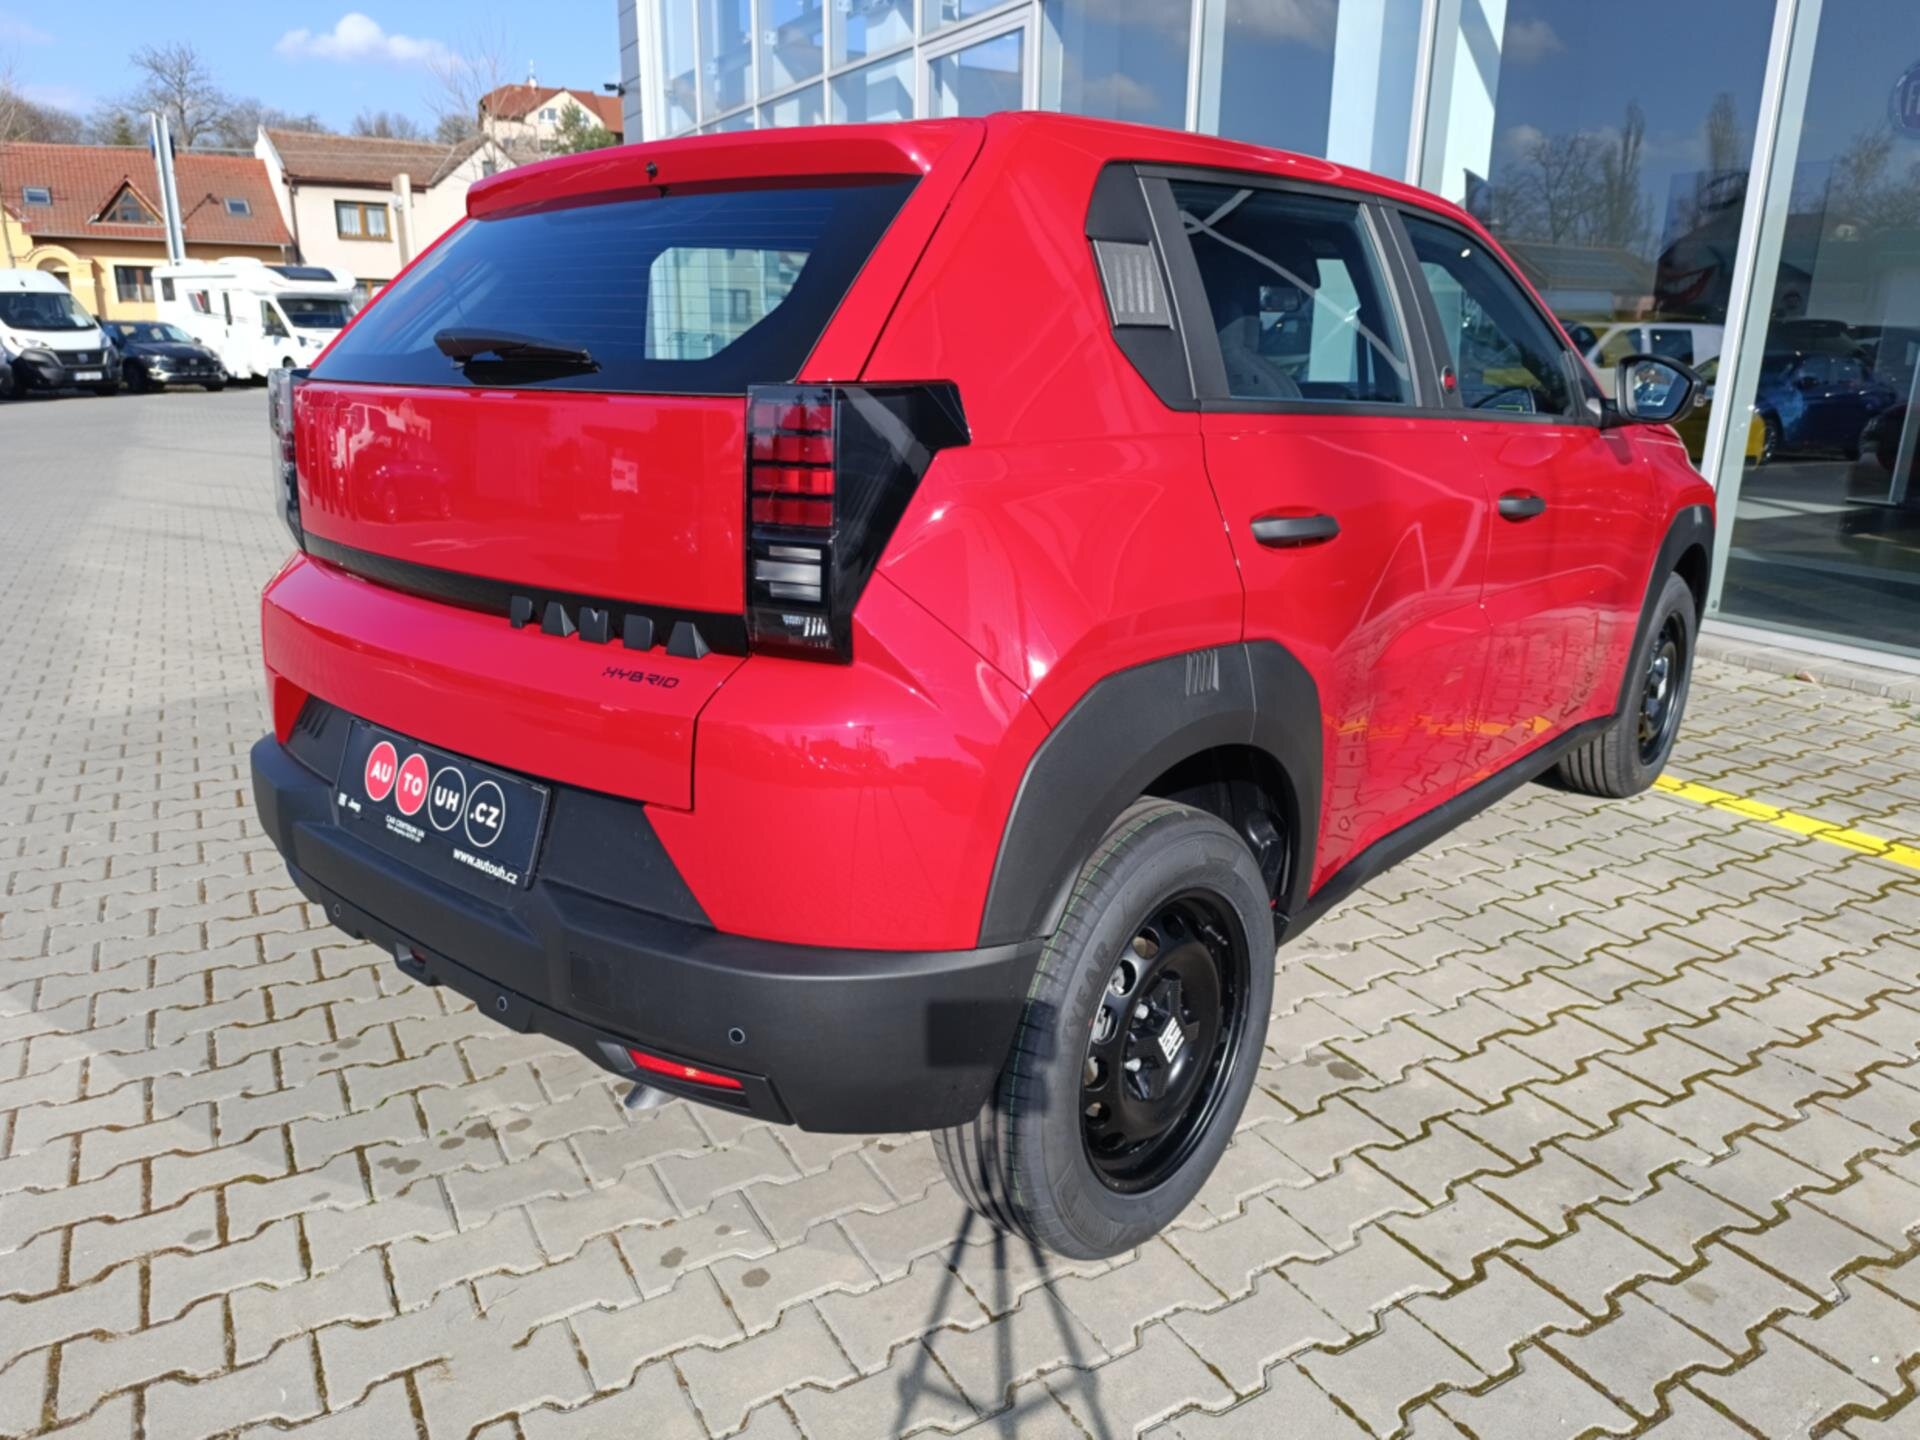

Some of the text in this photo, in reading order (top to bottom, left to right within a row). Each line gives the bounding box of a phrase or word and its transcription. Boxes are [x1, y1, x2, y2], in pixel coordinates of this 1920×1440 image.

[510, 595, 711, 661] PANDA
[602, 666, 680, 689] HYBRID
[469, 802, 500, 829] .CZ
[453, 848, 518, 885] www.autouh.cz
